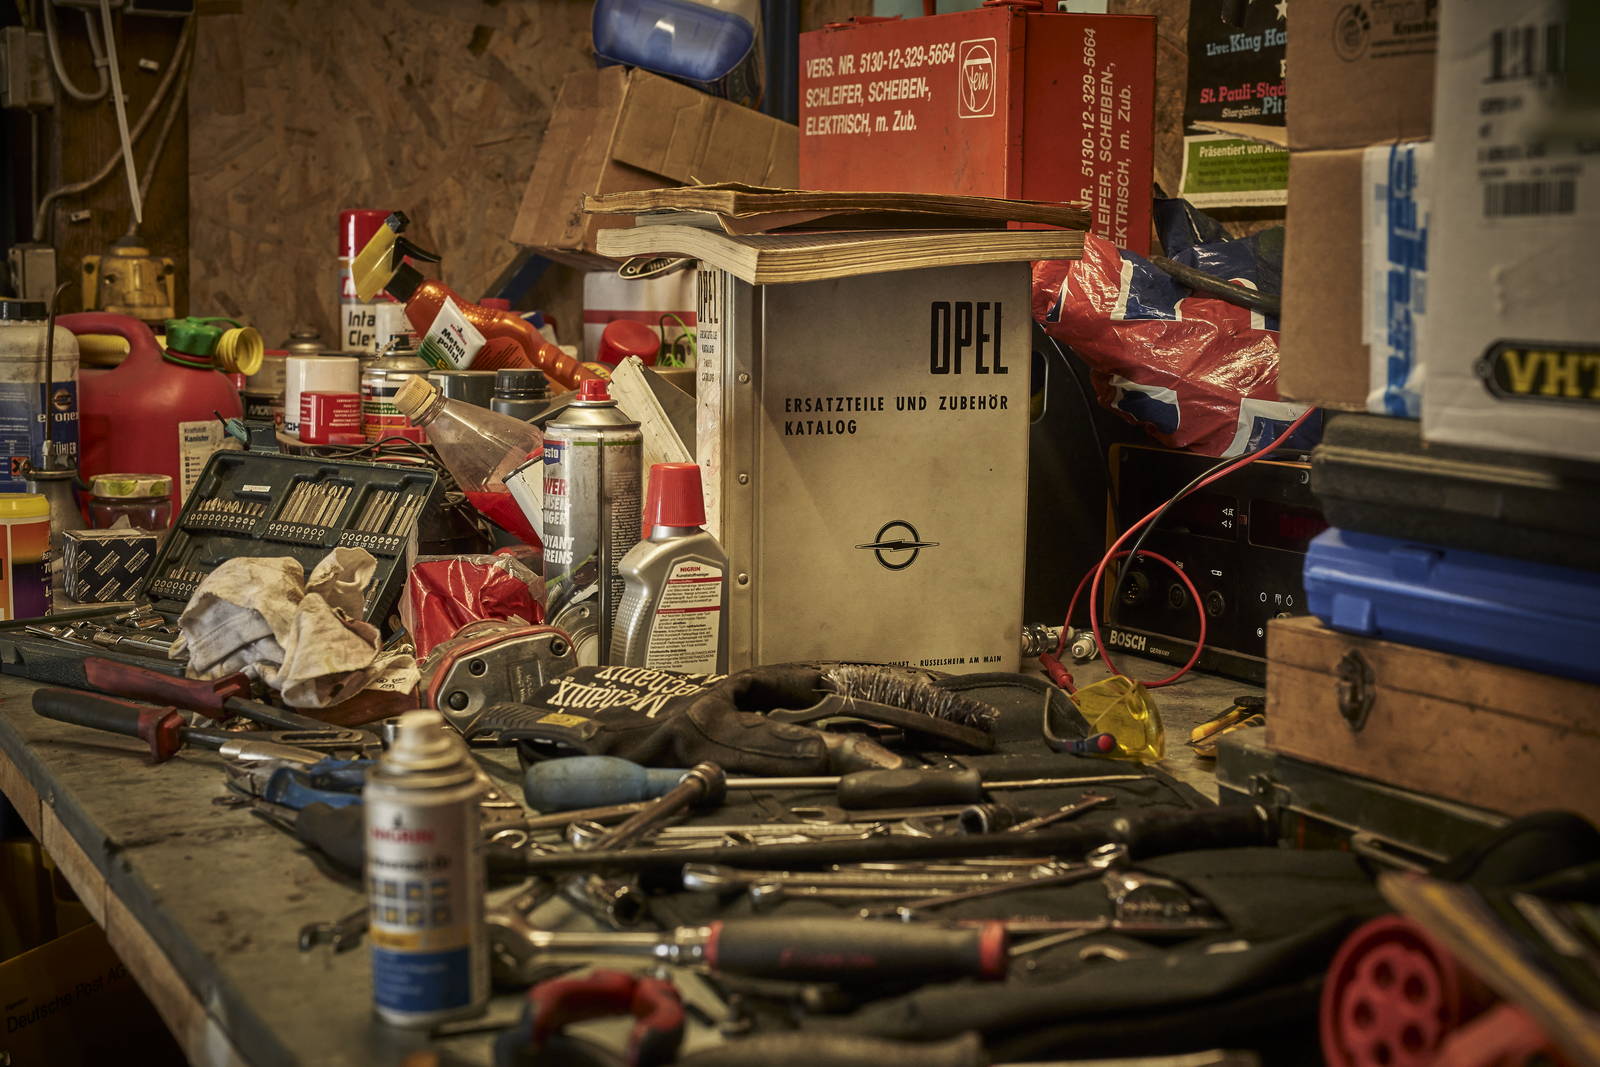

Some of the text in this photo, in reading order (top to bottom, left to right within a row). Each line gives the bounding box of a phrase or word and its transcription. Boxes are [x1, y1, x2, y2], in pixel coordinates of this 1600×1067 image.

[1206, 42, 1230, 56] Live:
[1230, 33, 1262, 53] King
[806, 42, 956, 78] VERS. NR. 5130-12-329-5664
[805, 77, 932, 107] SCHLEIFER, SCHEIBEN-,
[1081, 27, 1097, 178] 5130-12-329-5664
[1118, 83, 1132, 122] Zub.
[1200, 88, 1217, 103] St.
[1262, 96, 1282, 115] Pit
[805, 110, 917, 137] ELEKTRISCH, m. Zub.
[1100, 61, 1117, 163] SCHEIBEN-,
[1119, 130, 1131, 151] m.
[1199, 144, 1246, 158] Präsentiert
[1247, 145, 1264, 155] von
[697, 270, 719, 324] OPEL
[348, 310, 376, 327] Inta
[349, 330, 376, 348] Cle
[436, 336, 461, 365] polish
[440, 327, 466, 359] Metall
[930, 301, 1009, 375] OPEL
[785, 394, 1009, 413] ERSATZTEILE UND ZUBEHÖR
[785, 419, 858, 436] KATALOG
[544, 447, 560, 459] esto
[1109, 629, 1170, 657] BOSCH GERMANY
[983, 655, 1002, 663] MAIN
[6, 992, 73, 1034] Deutsche
[75, 976, 104, 1000] Post
[107, 963, 127, 984] AG
